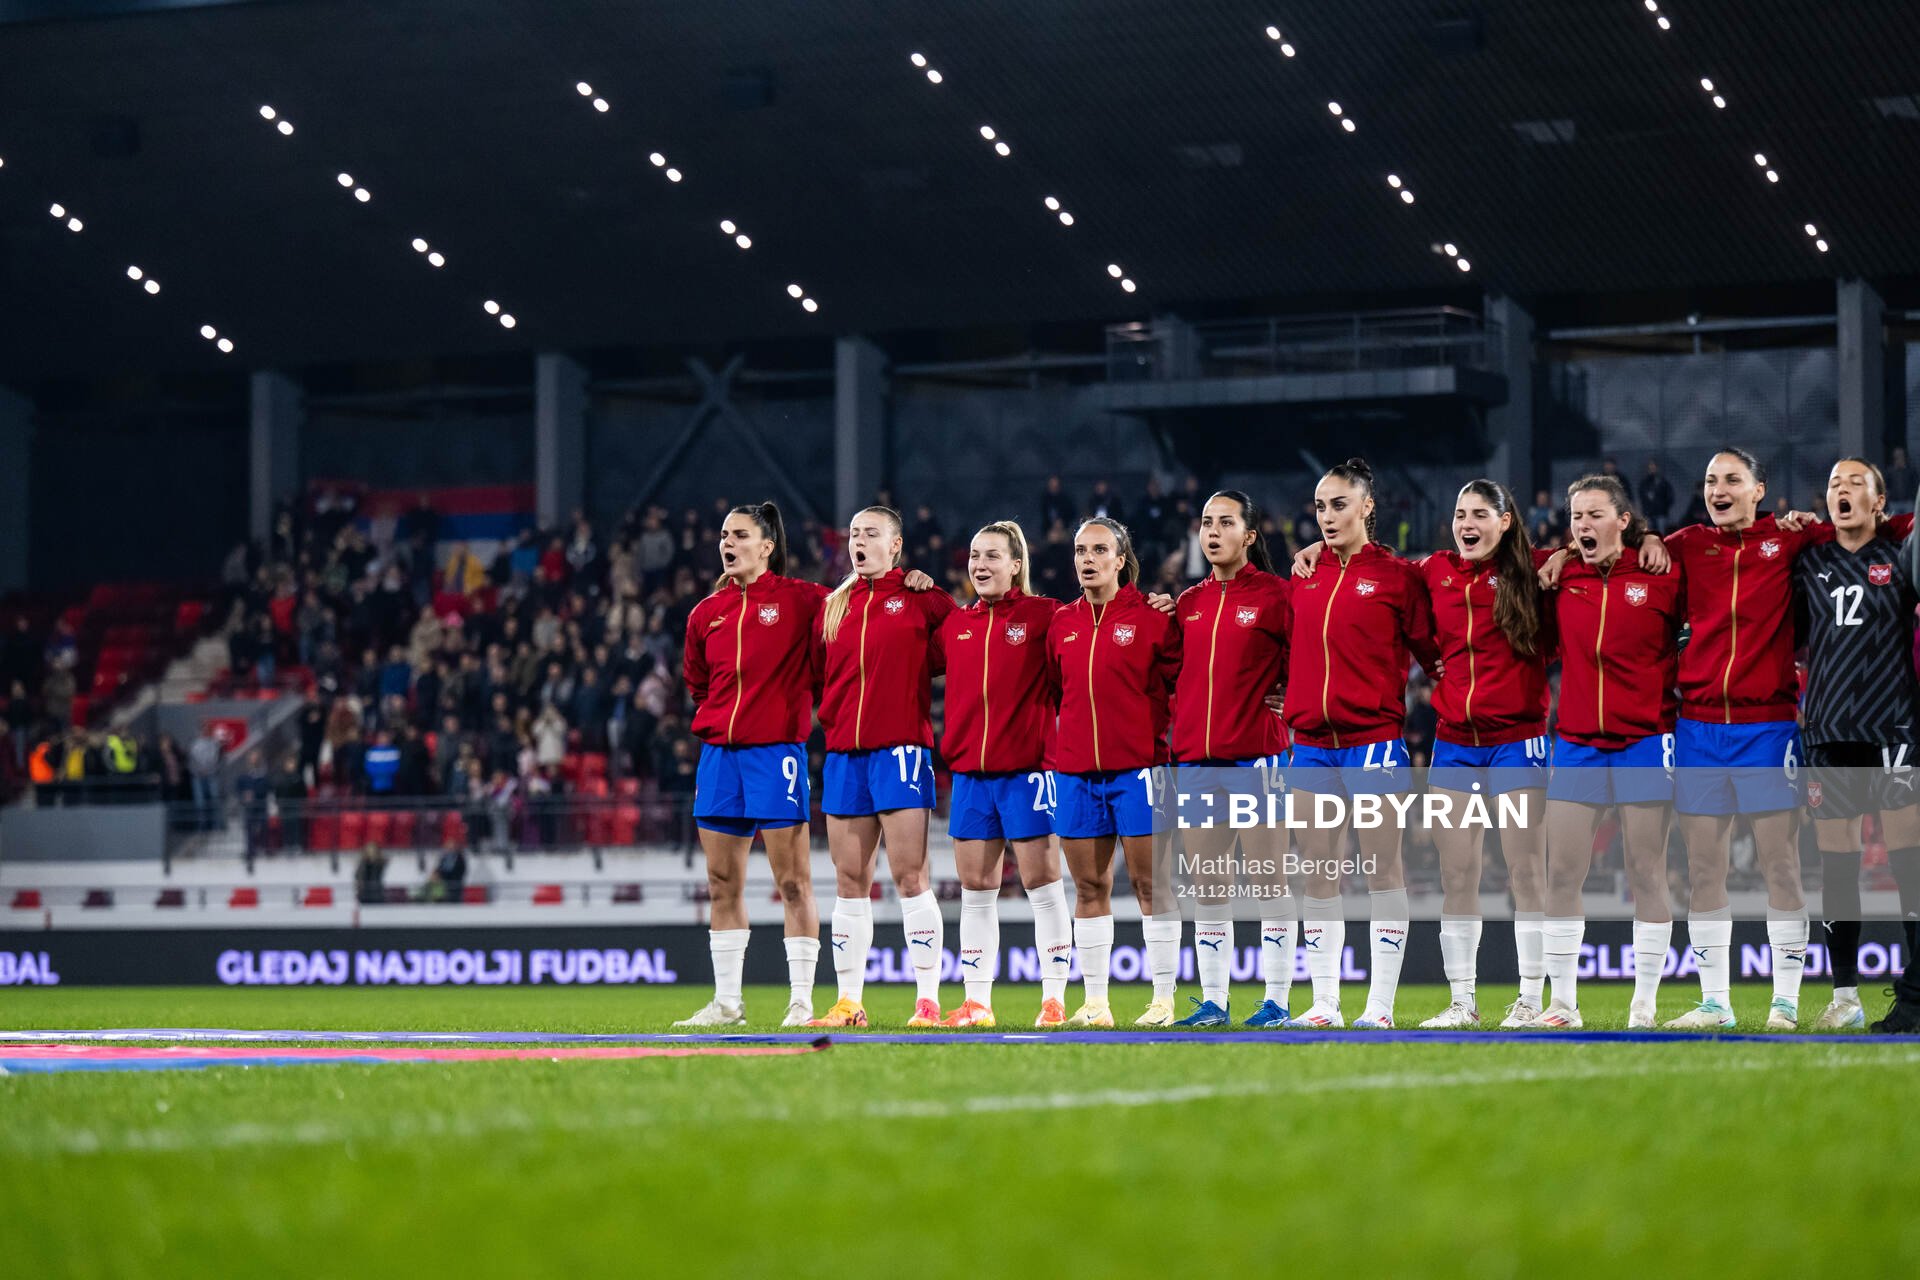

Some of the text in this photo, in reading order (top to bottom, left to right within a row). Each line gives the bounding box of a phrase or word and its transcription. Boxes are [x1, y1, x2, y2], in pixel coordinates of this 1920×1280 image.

[1830, 584, 1863, 626] 12
[892, 745, 922, 782] 17
[1661, 733, 1676, 773] 8
[1783, 739, 1798, 780] 6
[782, 756, 798, 794] 9
[1028, 770, 1057, 811] 20
[1137, 766, 1166, 806] 19
[1253, 754, 1286, 795] 14
[216, 949, 677, 985] GLEDAJ NAJBOLJI FUDBAL
